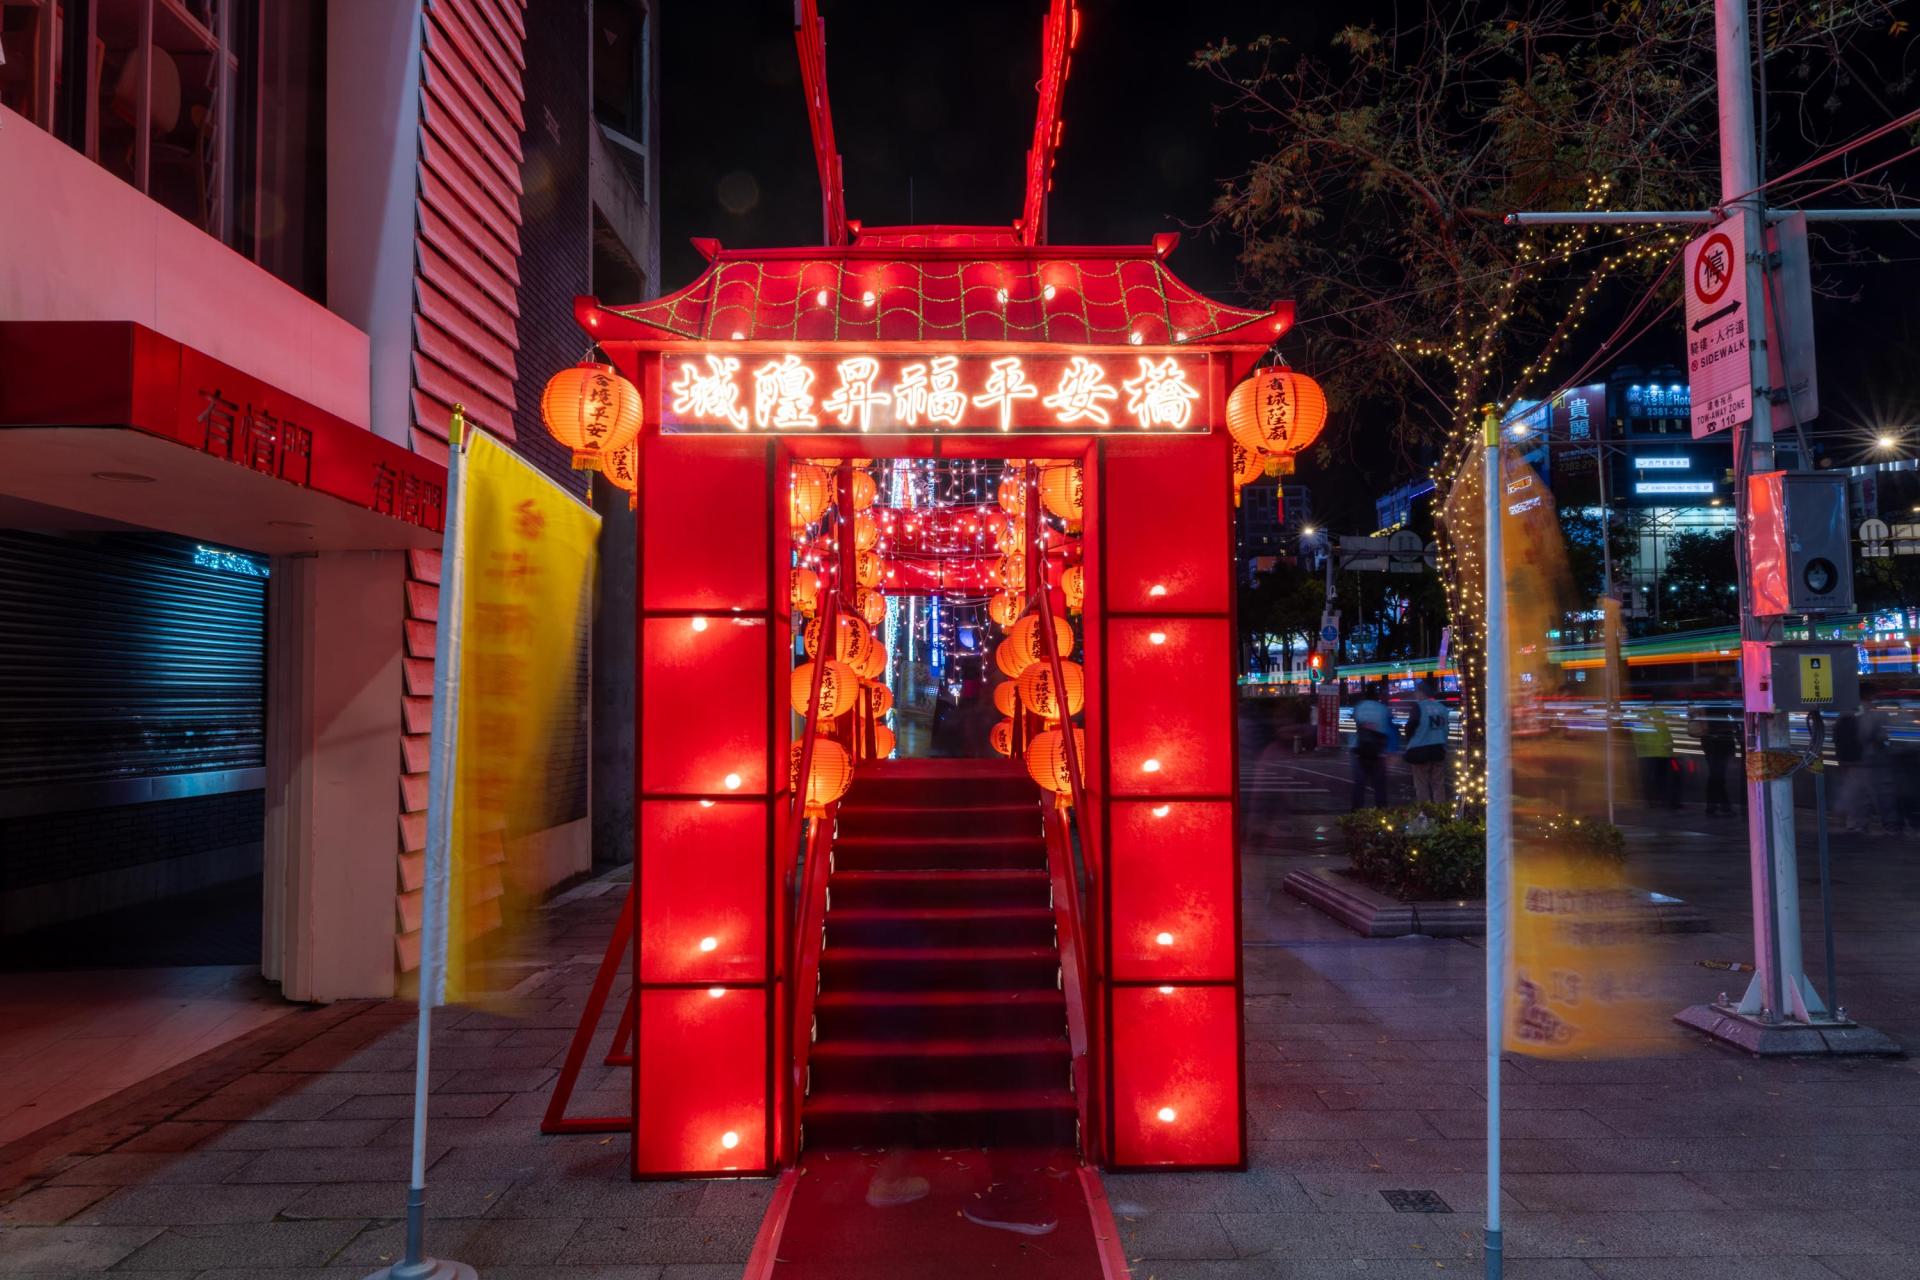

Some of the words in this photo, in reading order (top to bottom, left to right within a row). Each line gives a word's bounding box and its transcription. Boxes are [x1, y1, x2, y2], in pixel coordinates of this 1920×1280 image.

[1700, 338, 1746, 368] SIDEWALK
[586, 374, 614, 438] 合境平安
[671, 353, 1201, 433] 城隍昇福平安橋
[1647, 407, 1690, 416] 2381-263
[1697, 406, 1727, 425] TOW-AWAY
[1728, 398, 1745, 413] ZONE
[197, 389, 313, 489] 有情門
[1721, 413, 1736, 427] 110
[371, 461, 443, 533] 有情門
